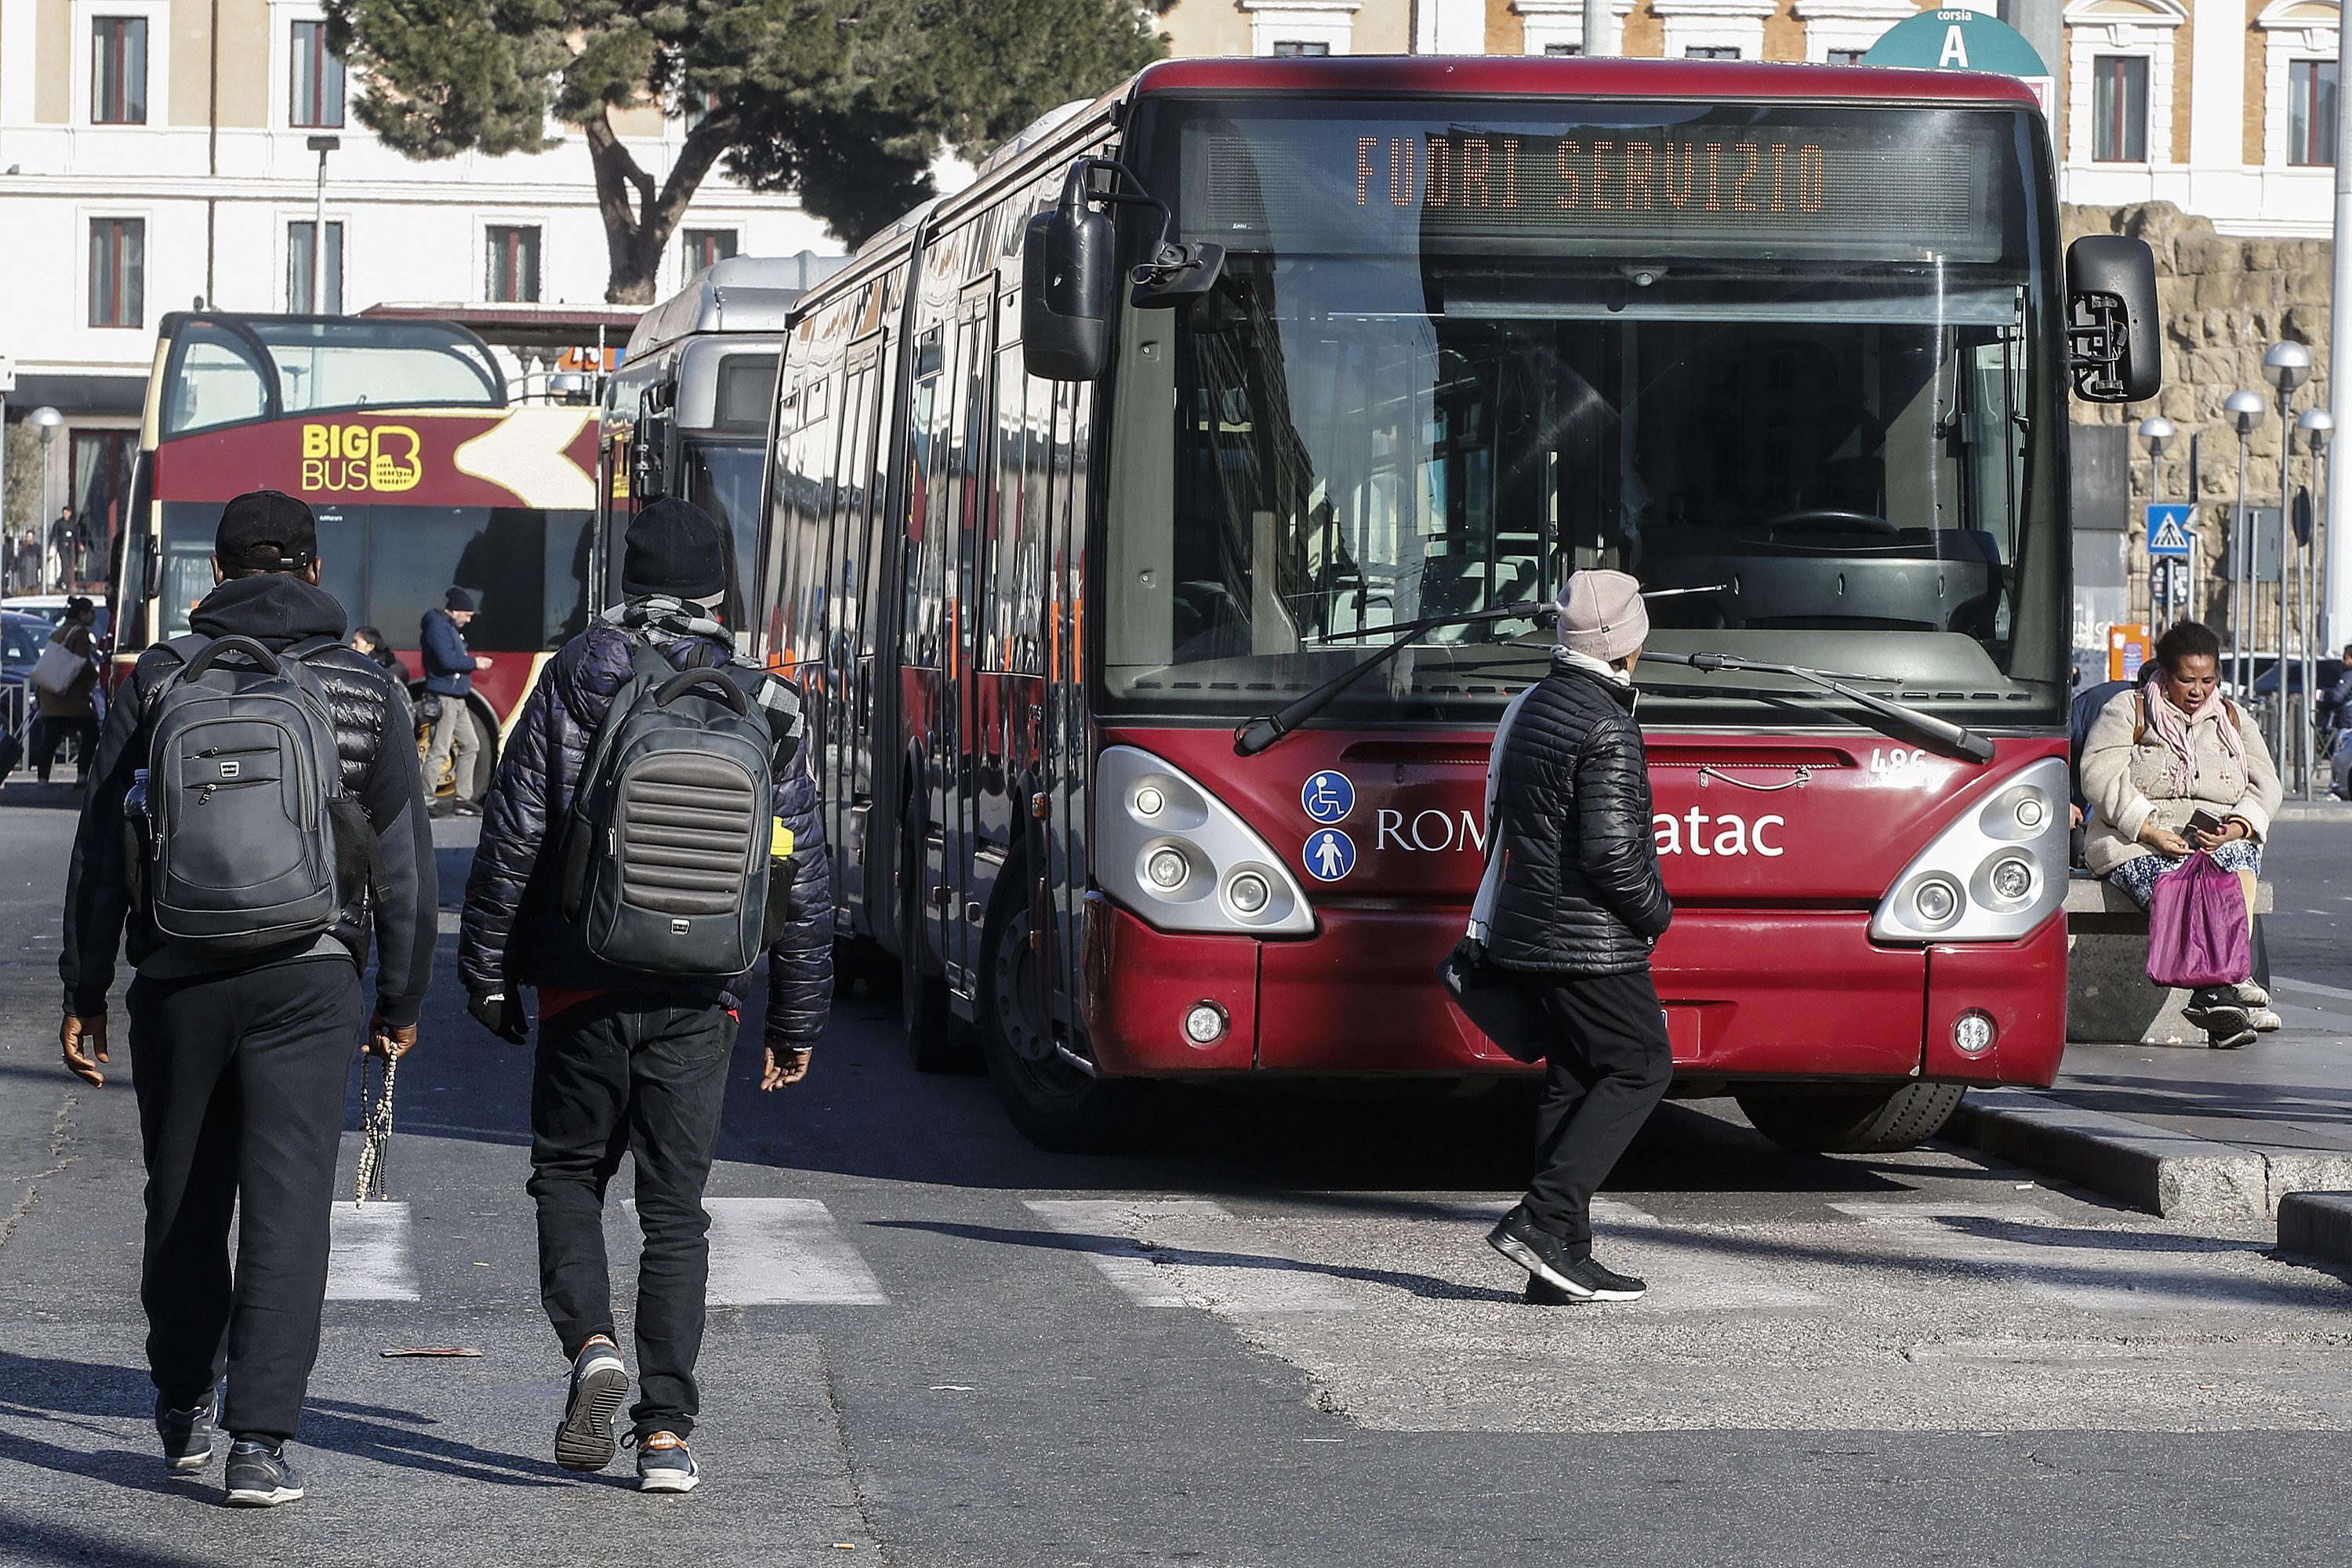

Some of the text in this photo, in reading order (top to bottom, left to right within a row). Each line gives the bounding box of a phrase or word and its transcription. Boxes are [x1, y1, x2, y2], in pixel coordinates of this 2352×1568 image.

[1936, 9, 1973, 21] corsia
[1939, 25, 1969, 68] A
[1357, 137, 1823, 212] FUORI SERVIZIO
[302, 423, 369, 459] BIG
[302, 459, 368, 491] BUS
[1653, 805, 1784, 857] atac
